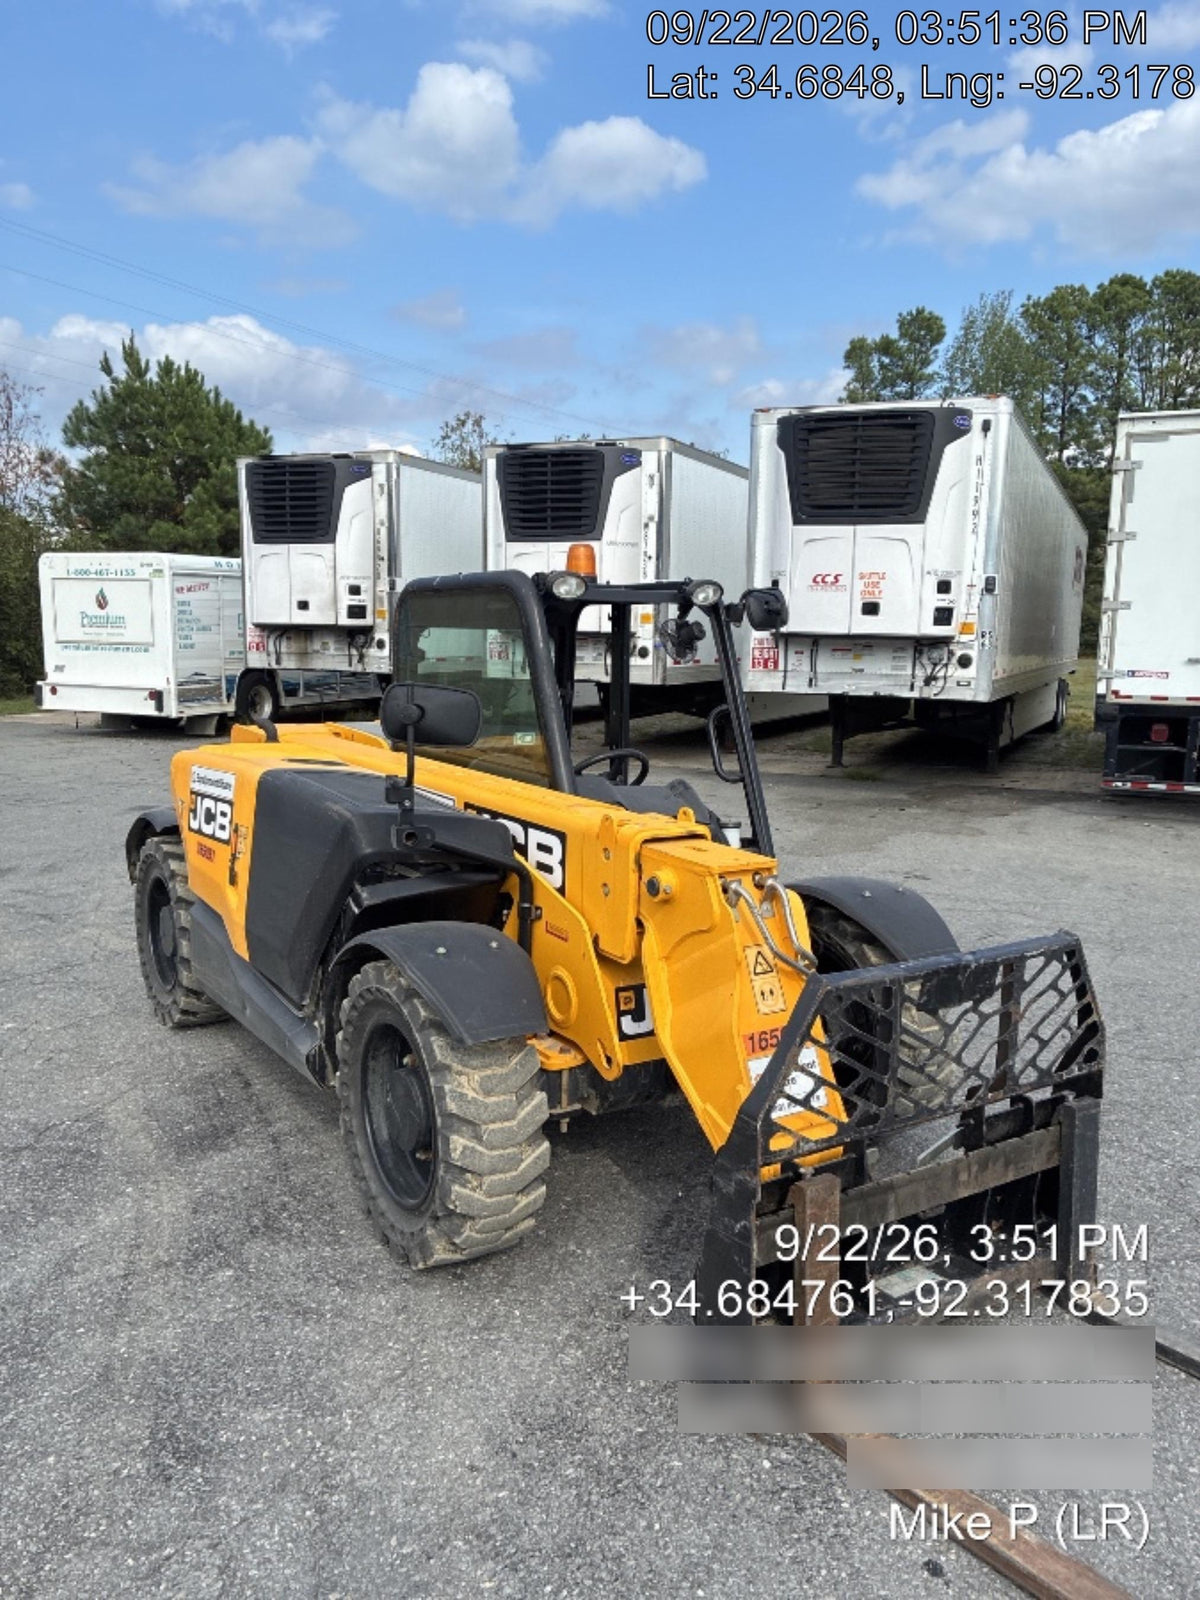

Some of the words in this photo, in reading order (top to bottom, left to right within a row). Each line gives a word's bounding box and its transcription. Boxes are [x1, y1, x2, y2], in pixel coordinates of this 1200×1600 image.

[811, 573, 843, 585] CCS
[864, 581, 880, 589] USE
[189, 795, 232, 842] JCB
[748, 1027, 786, 1053] 165
